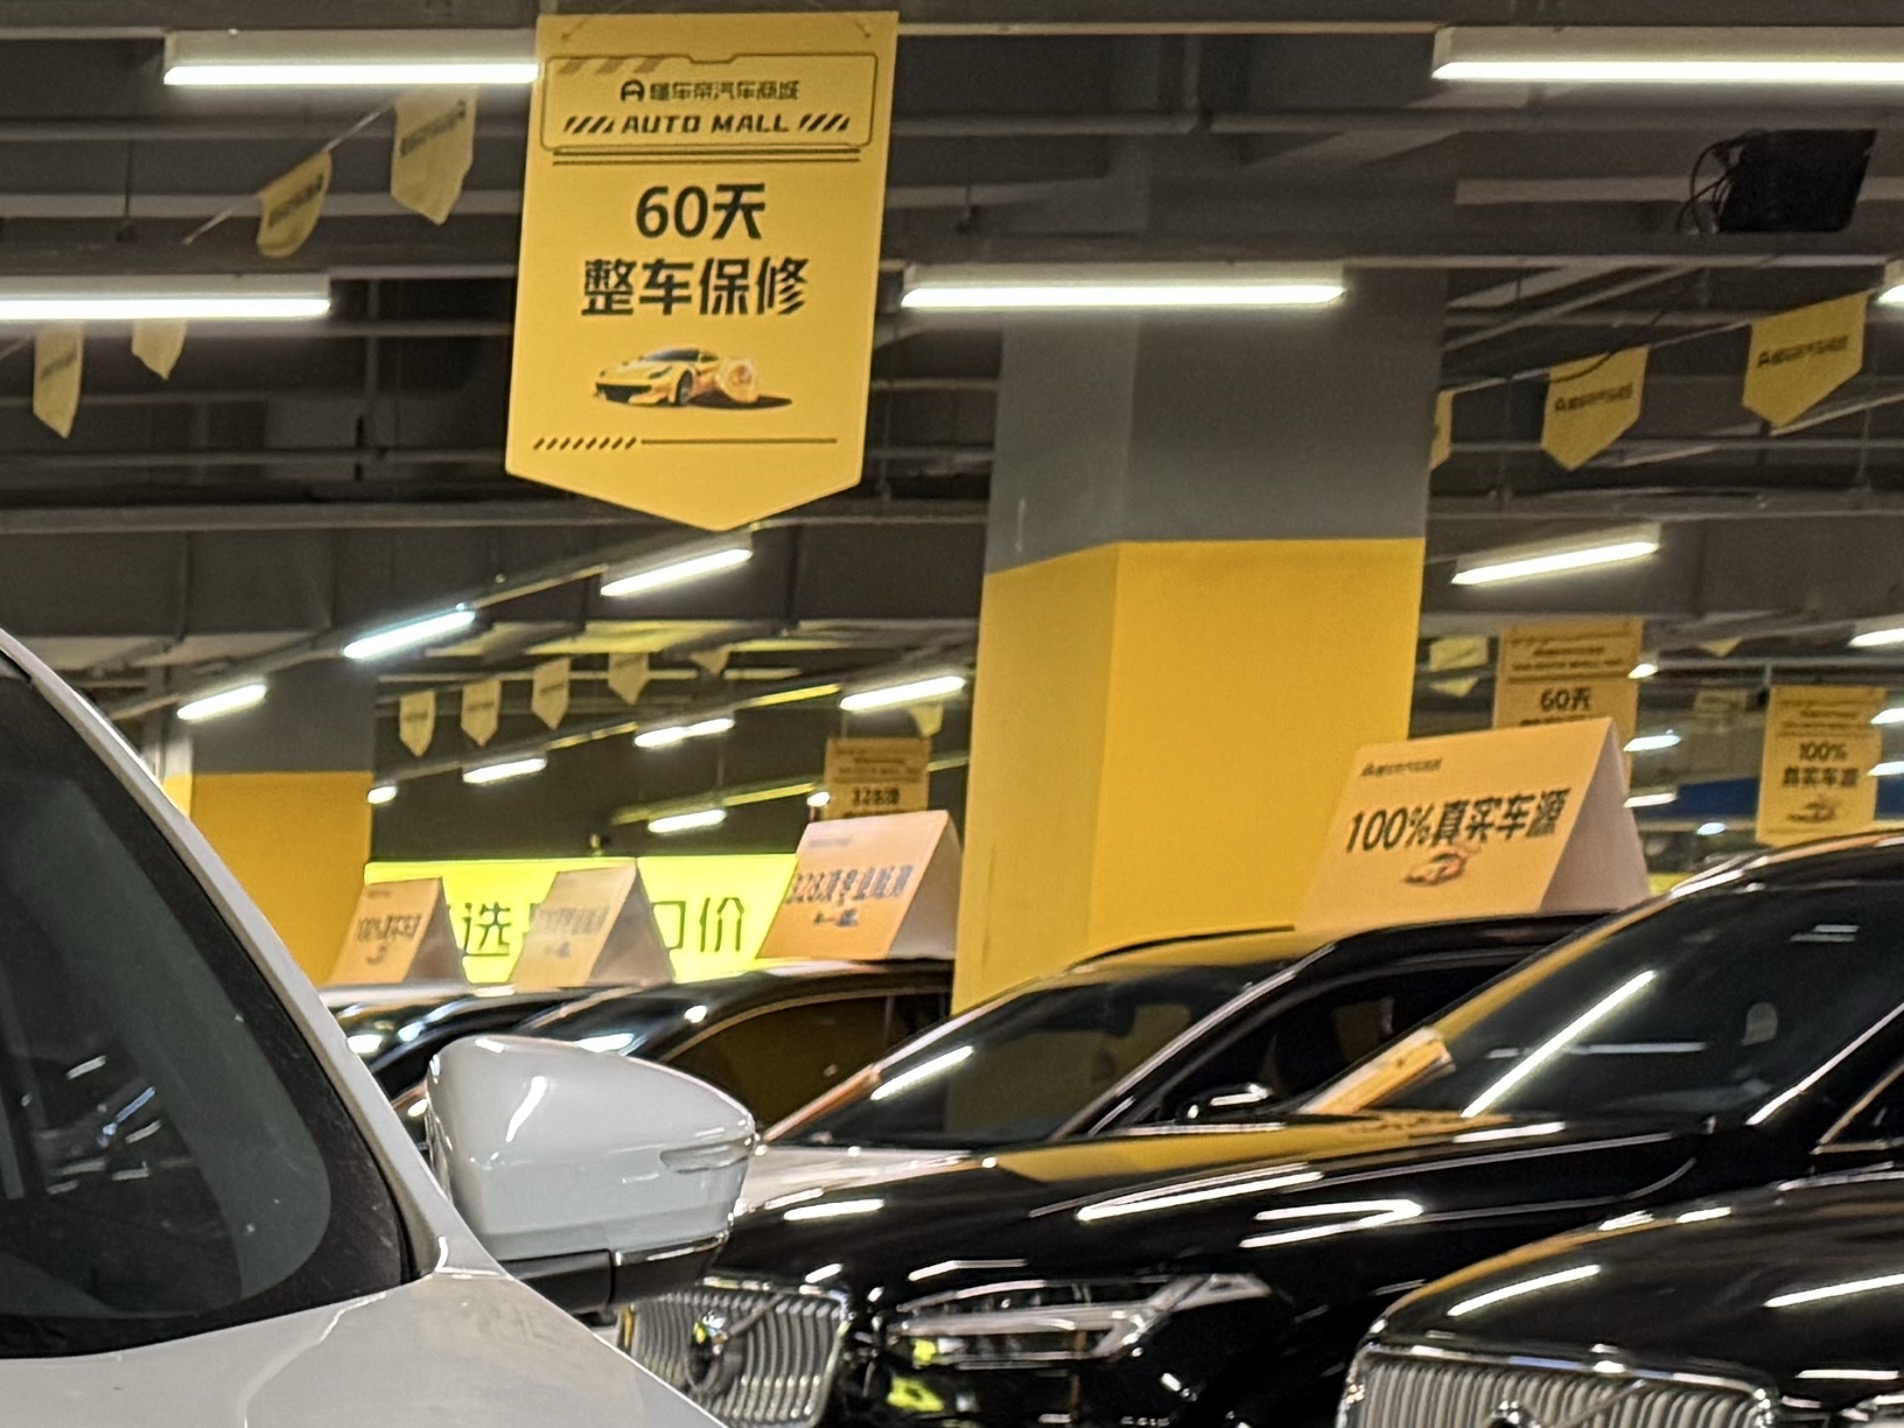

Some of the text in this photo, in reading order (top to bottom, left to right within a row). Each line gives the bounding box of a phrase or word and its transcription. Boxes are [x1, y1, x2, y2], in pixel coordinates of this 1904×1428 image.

[621, 114, 789, 134] AUTO MALL
[635, 183, 765, 240] 60天
[581, 256, 809, 317] 整车保修
